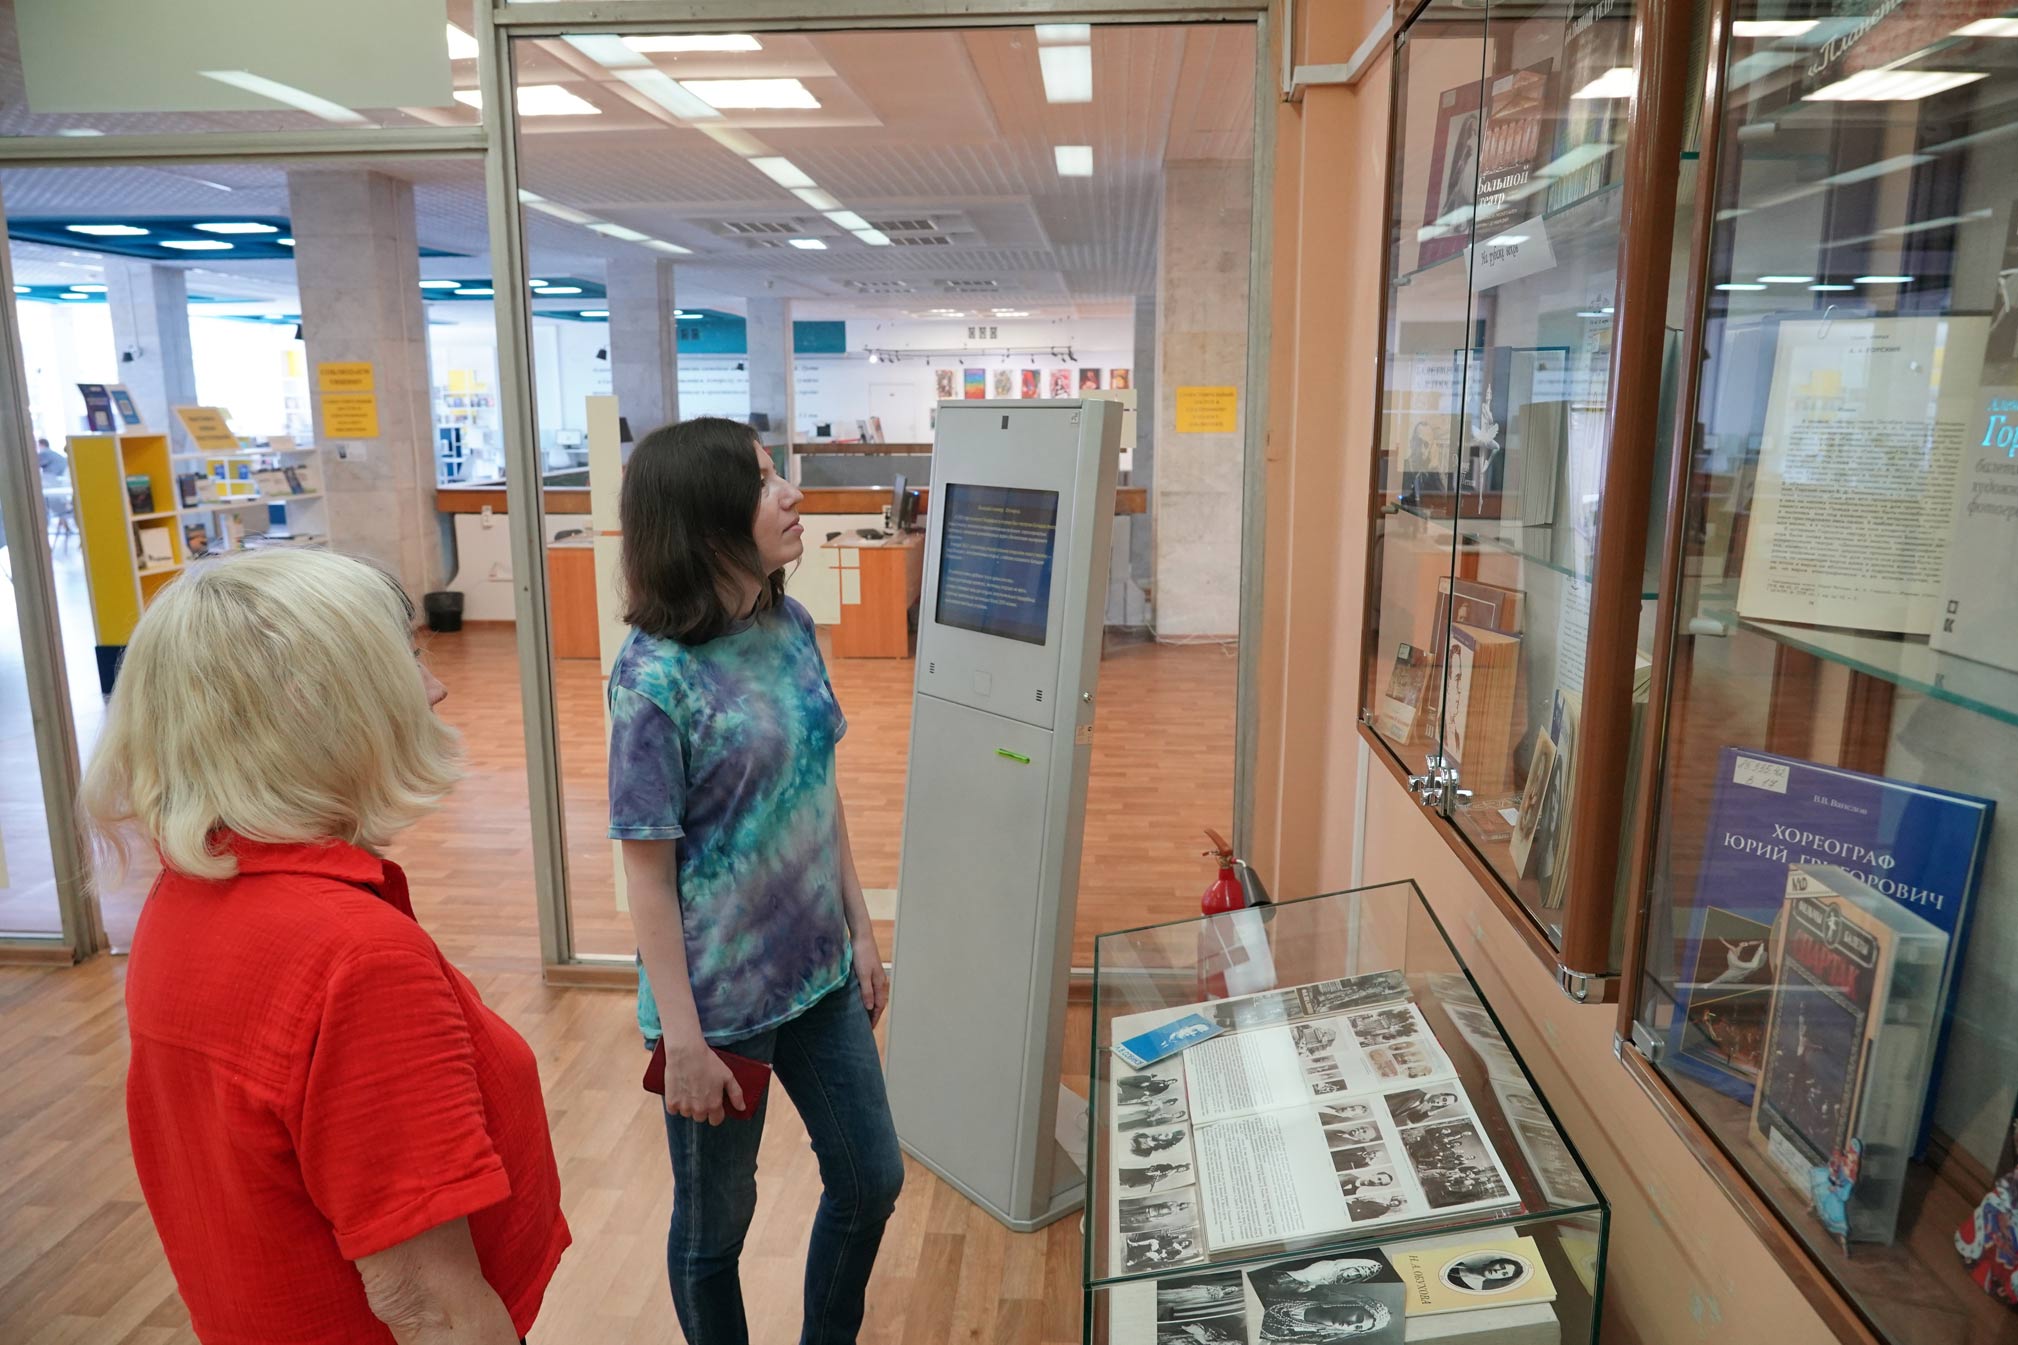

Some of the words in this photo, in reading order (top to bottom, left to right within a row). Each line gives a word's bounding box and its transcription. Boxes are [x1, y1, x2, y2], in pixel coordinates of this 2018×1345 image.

[1477, 192, 1506, 210] театр
[1723, 832, 1788, 864] ЮРИЙ
[1771, 823, 1896, 870] ХОРЕОГРАФ
